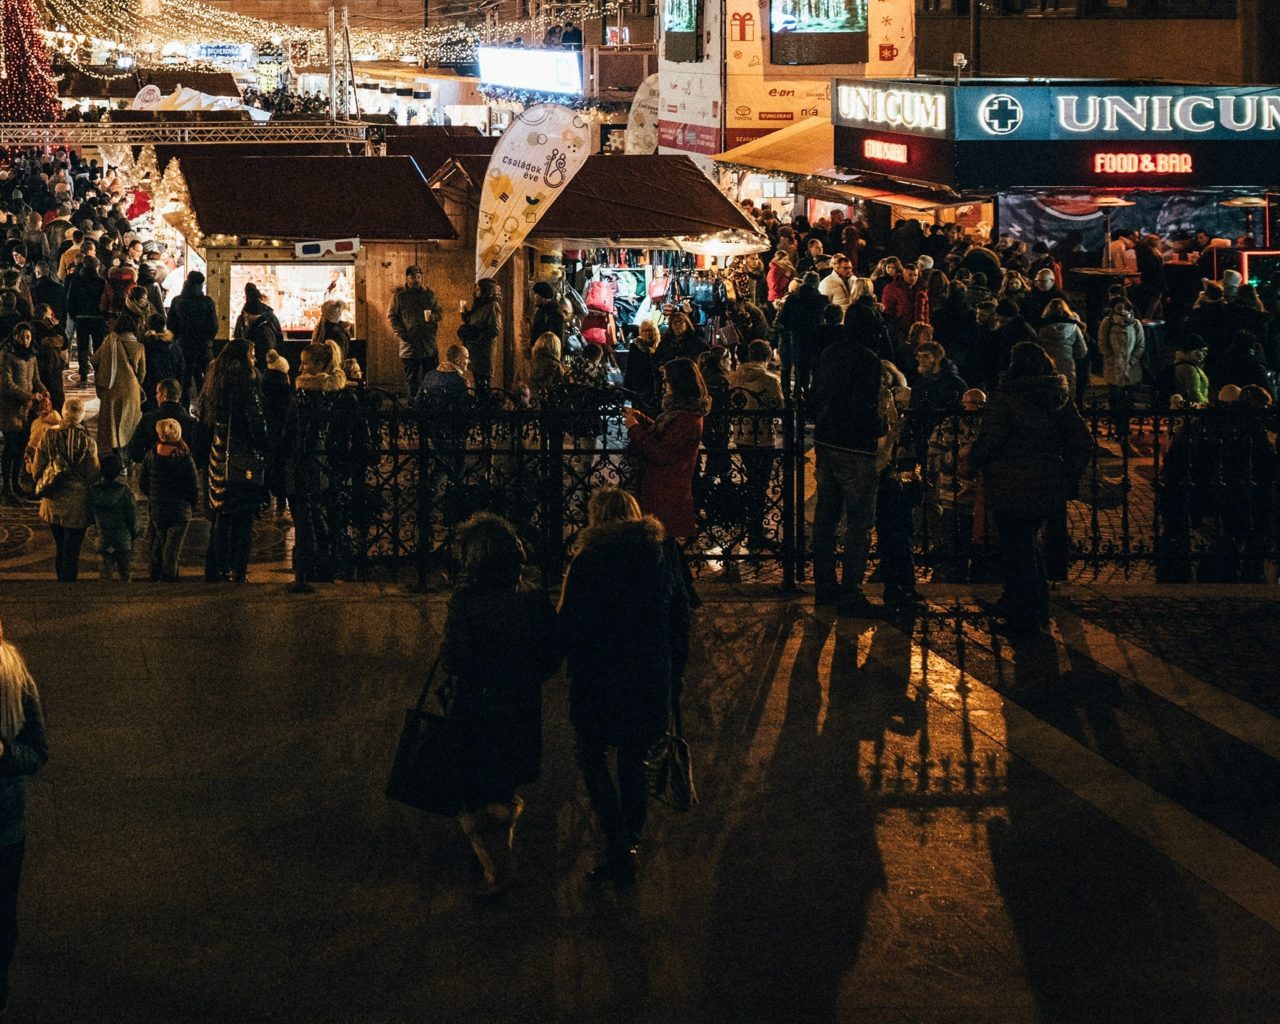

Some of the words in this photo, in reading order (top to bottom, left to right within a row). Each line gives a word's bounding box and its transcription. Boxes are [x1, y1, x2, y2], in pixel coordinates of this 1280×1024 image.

[838, 85, 946, 130] UNICUM
[502, 156, 542, 174] Családok
[523, 171, 539, 182] éve
